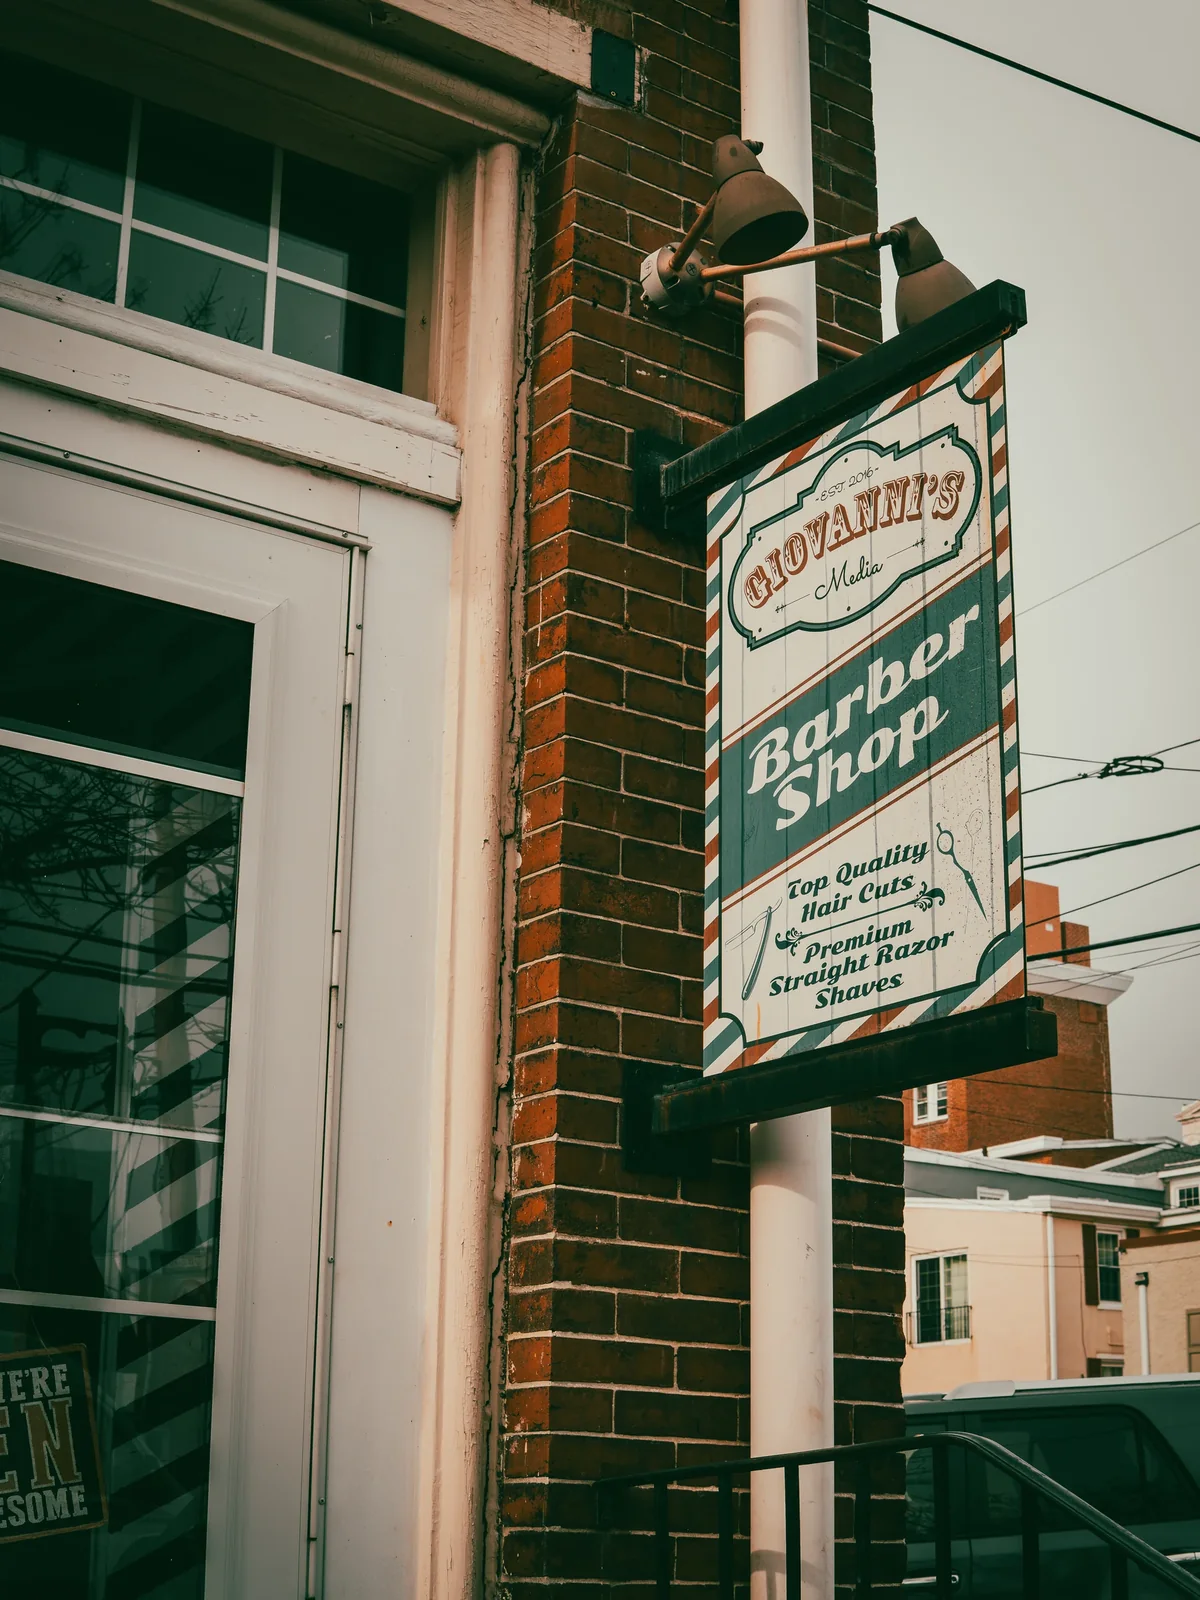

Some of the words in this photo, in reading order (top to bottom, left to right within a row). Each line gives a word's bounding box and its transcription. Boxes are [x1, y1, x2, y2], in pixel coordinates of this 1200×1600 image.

[744, 470, 965, 608] GIOVANNI'S
[815, 555, 883, 600] Media
[747, 604, 979, 794] Barber
[773, 696, 949, 831] Shop
[788, 875, 831, 900] Top
[836, 842, 931, 886] Quality
[801, 892, 853, 923] Hair
[859, 875, 916, 903] Cuts
[769, 954, 870, 997] Straight
[874, 931, 955, 966] Razor
[803, 919, 915, 964] Premium
[815, 973, 904, 1009] Shaves
[0, 1364, 71, 1403] E'RE
